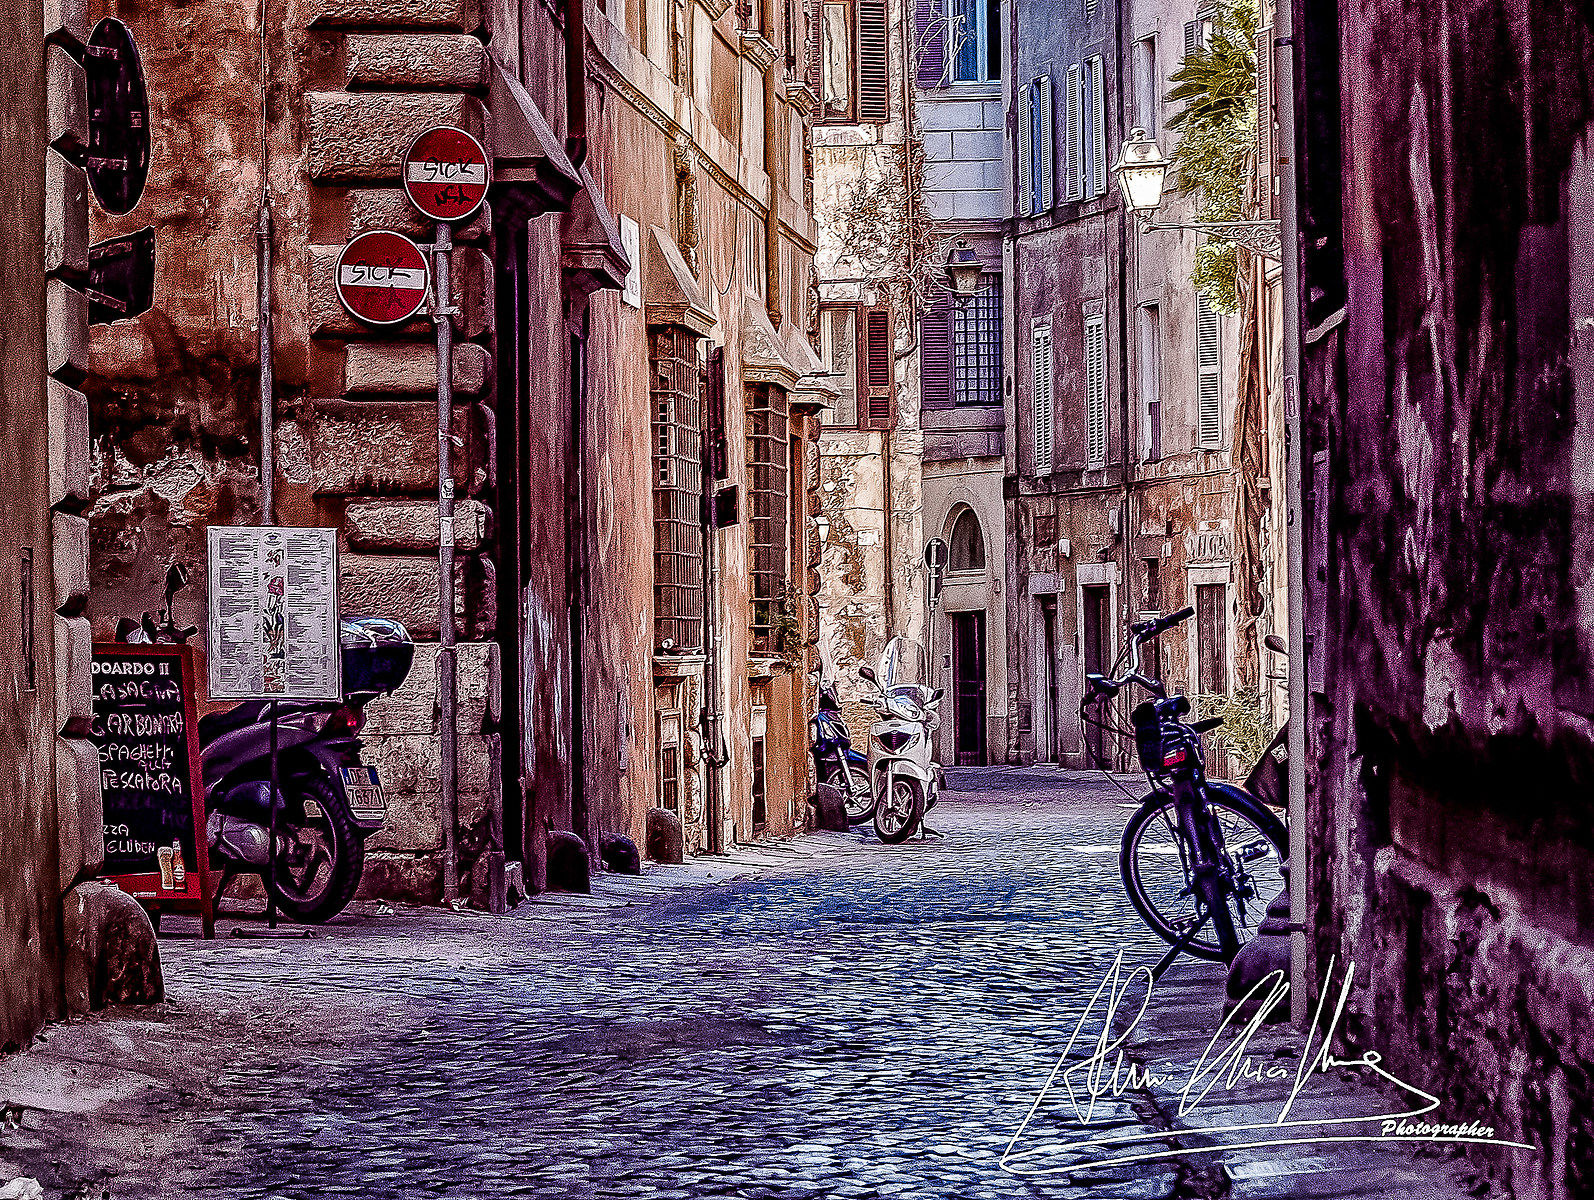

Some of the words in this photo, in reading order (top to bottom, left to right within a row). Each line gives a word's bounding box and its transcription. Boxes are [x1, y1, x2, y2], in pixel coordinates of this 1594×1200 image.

[423, 156, 475, 181] SICK
[351, 257, 412, 284] SICK
[90, 661, 155, 675] DOARDO
[102, 823, 129, 837] ZZA
